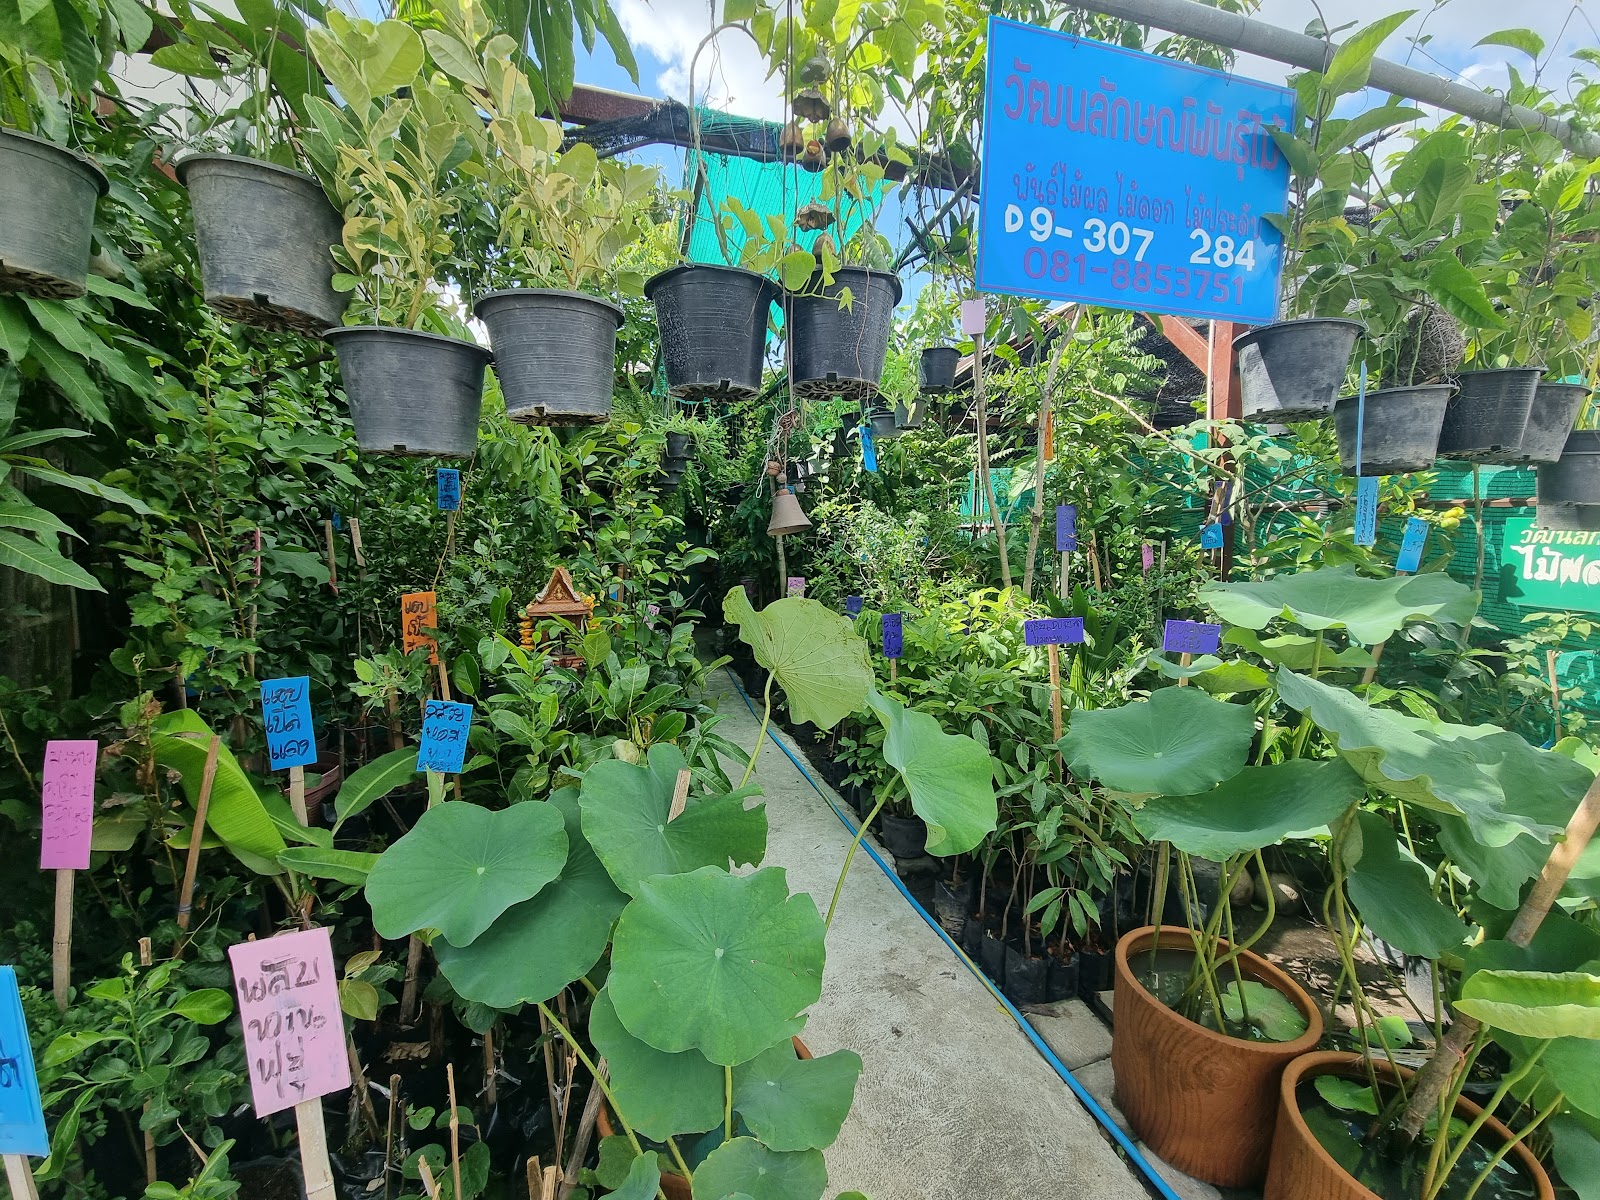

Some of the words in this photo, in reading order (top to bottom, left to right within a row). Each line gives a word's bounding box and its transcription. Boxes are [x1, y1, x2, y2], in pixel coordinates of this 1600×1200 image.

[1013, 161, 1108, 220] พันธุ์ไม้ผล
[1116, 171, 1176, 225] ไม้ดอก
[1184, 184, 1262, 240] ไม้ประดับ
[1023, 246, 1244, 305] 081-8853751
[1189, 228, 1256, 272] 284
